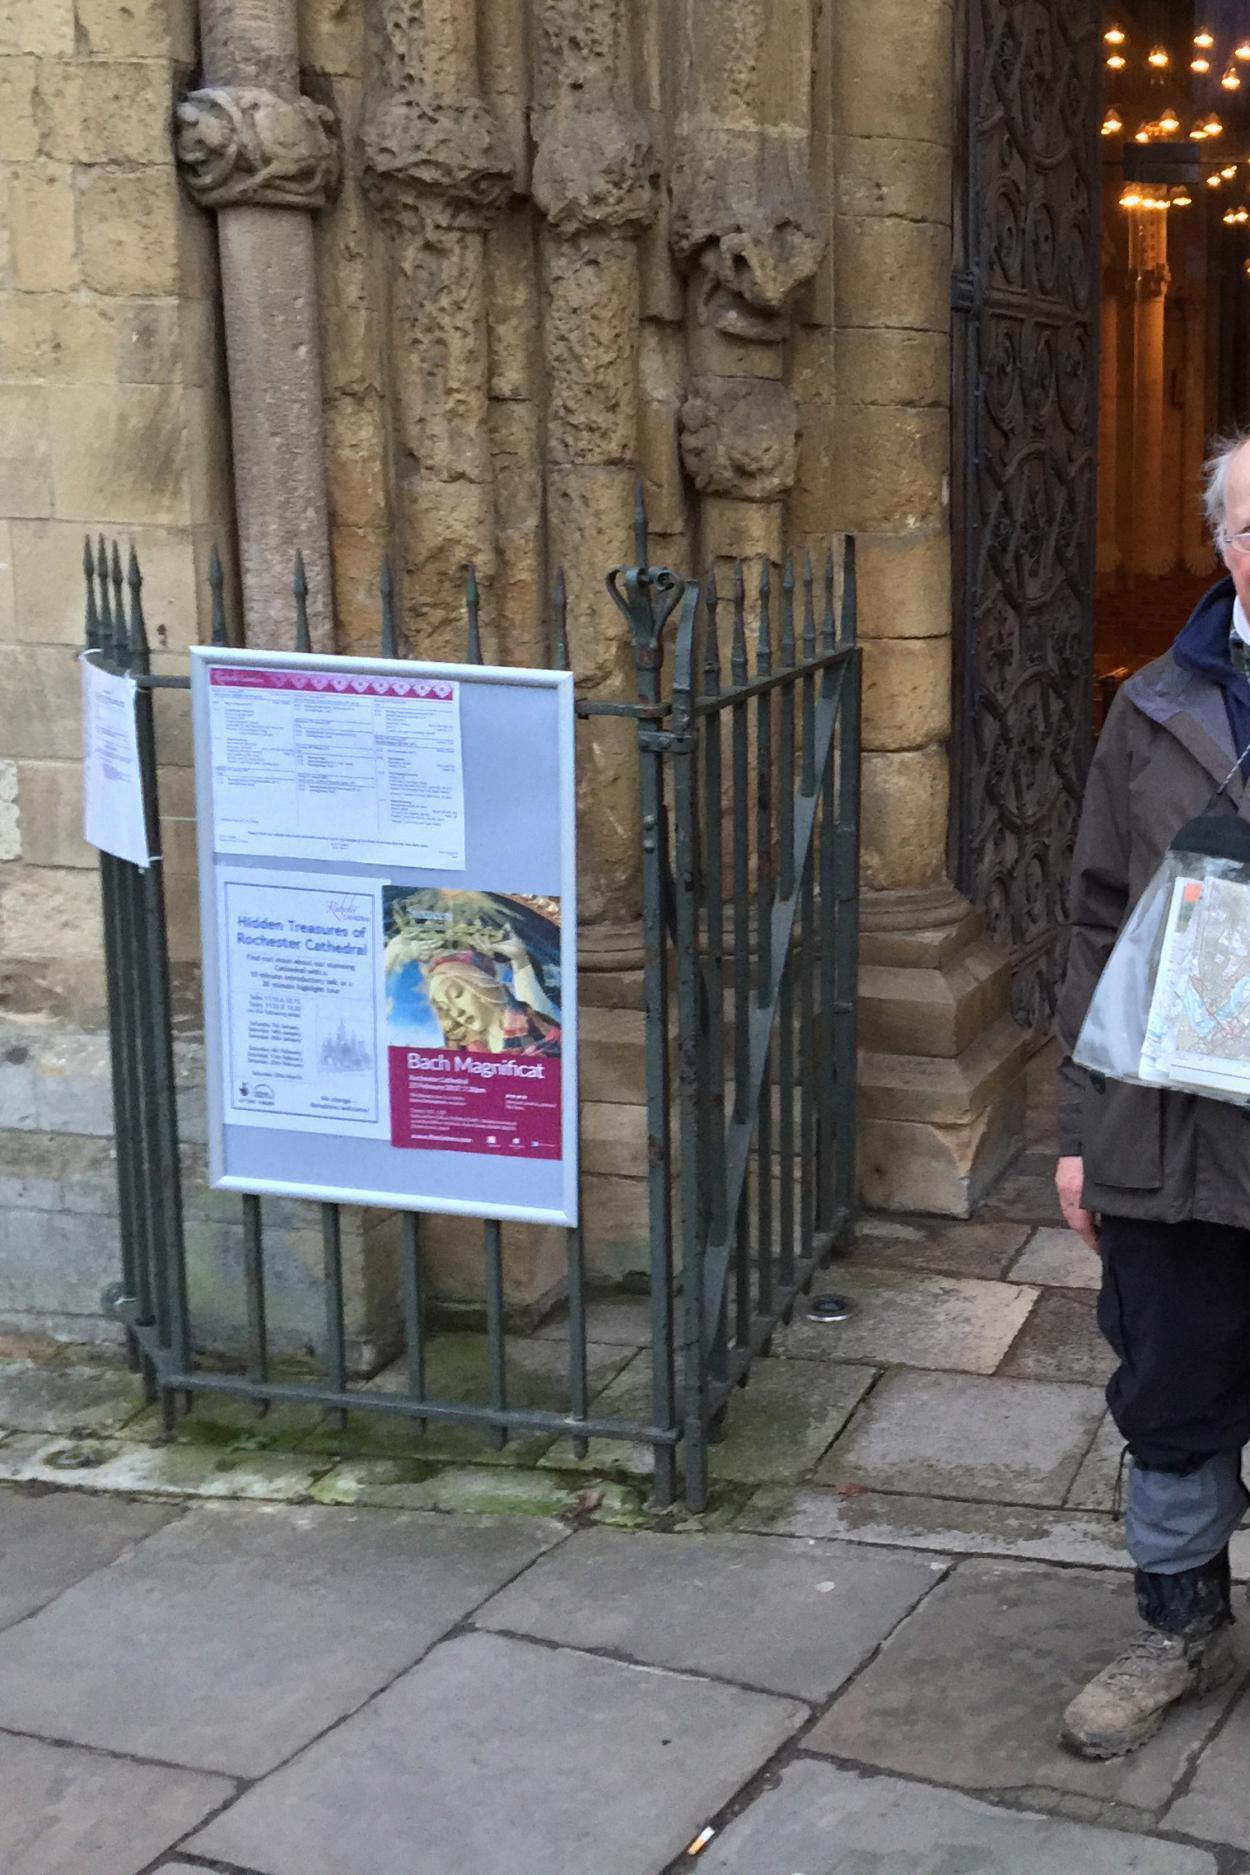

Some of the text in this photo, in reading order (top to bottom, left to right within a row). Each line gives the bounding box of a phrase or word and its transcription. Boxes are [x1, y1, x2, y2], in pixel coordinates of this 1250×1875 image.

[237, 916, 367, 938] Hidden Treasures of
[236, 932, 368, 956] Rochester Cathedral
[407, 1052, 545, 1079] Bach Magnificat
